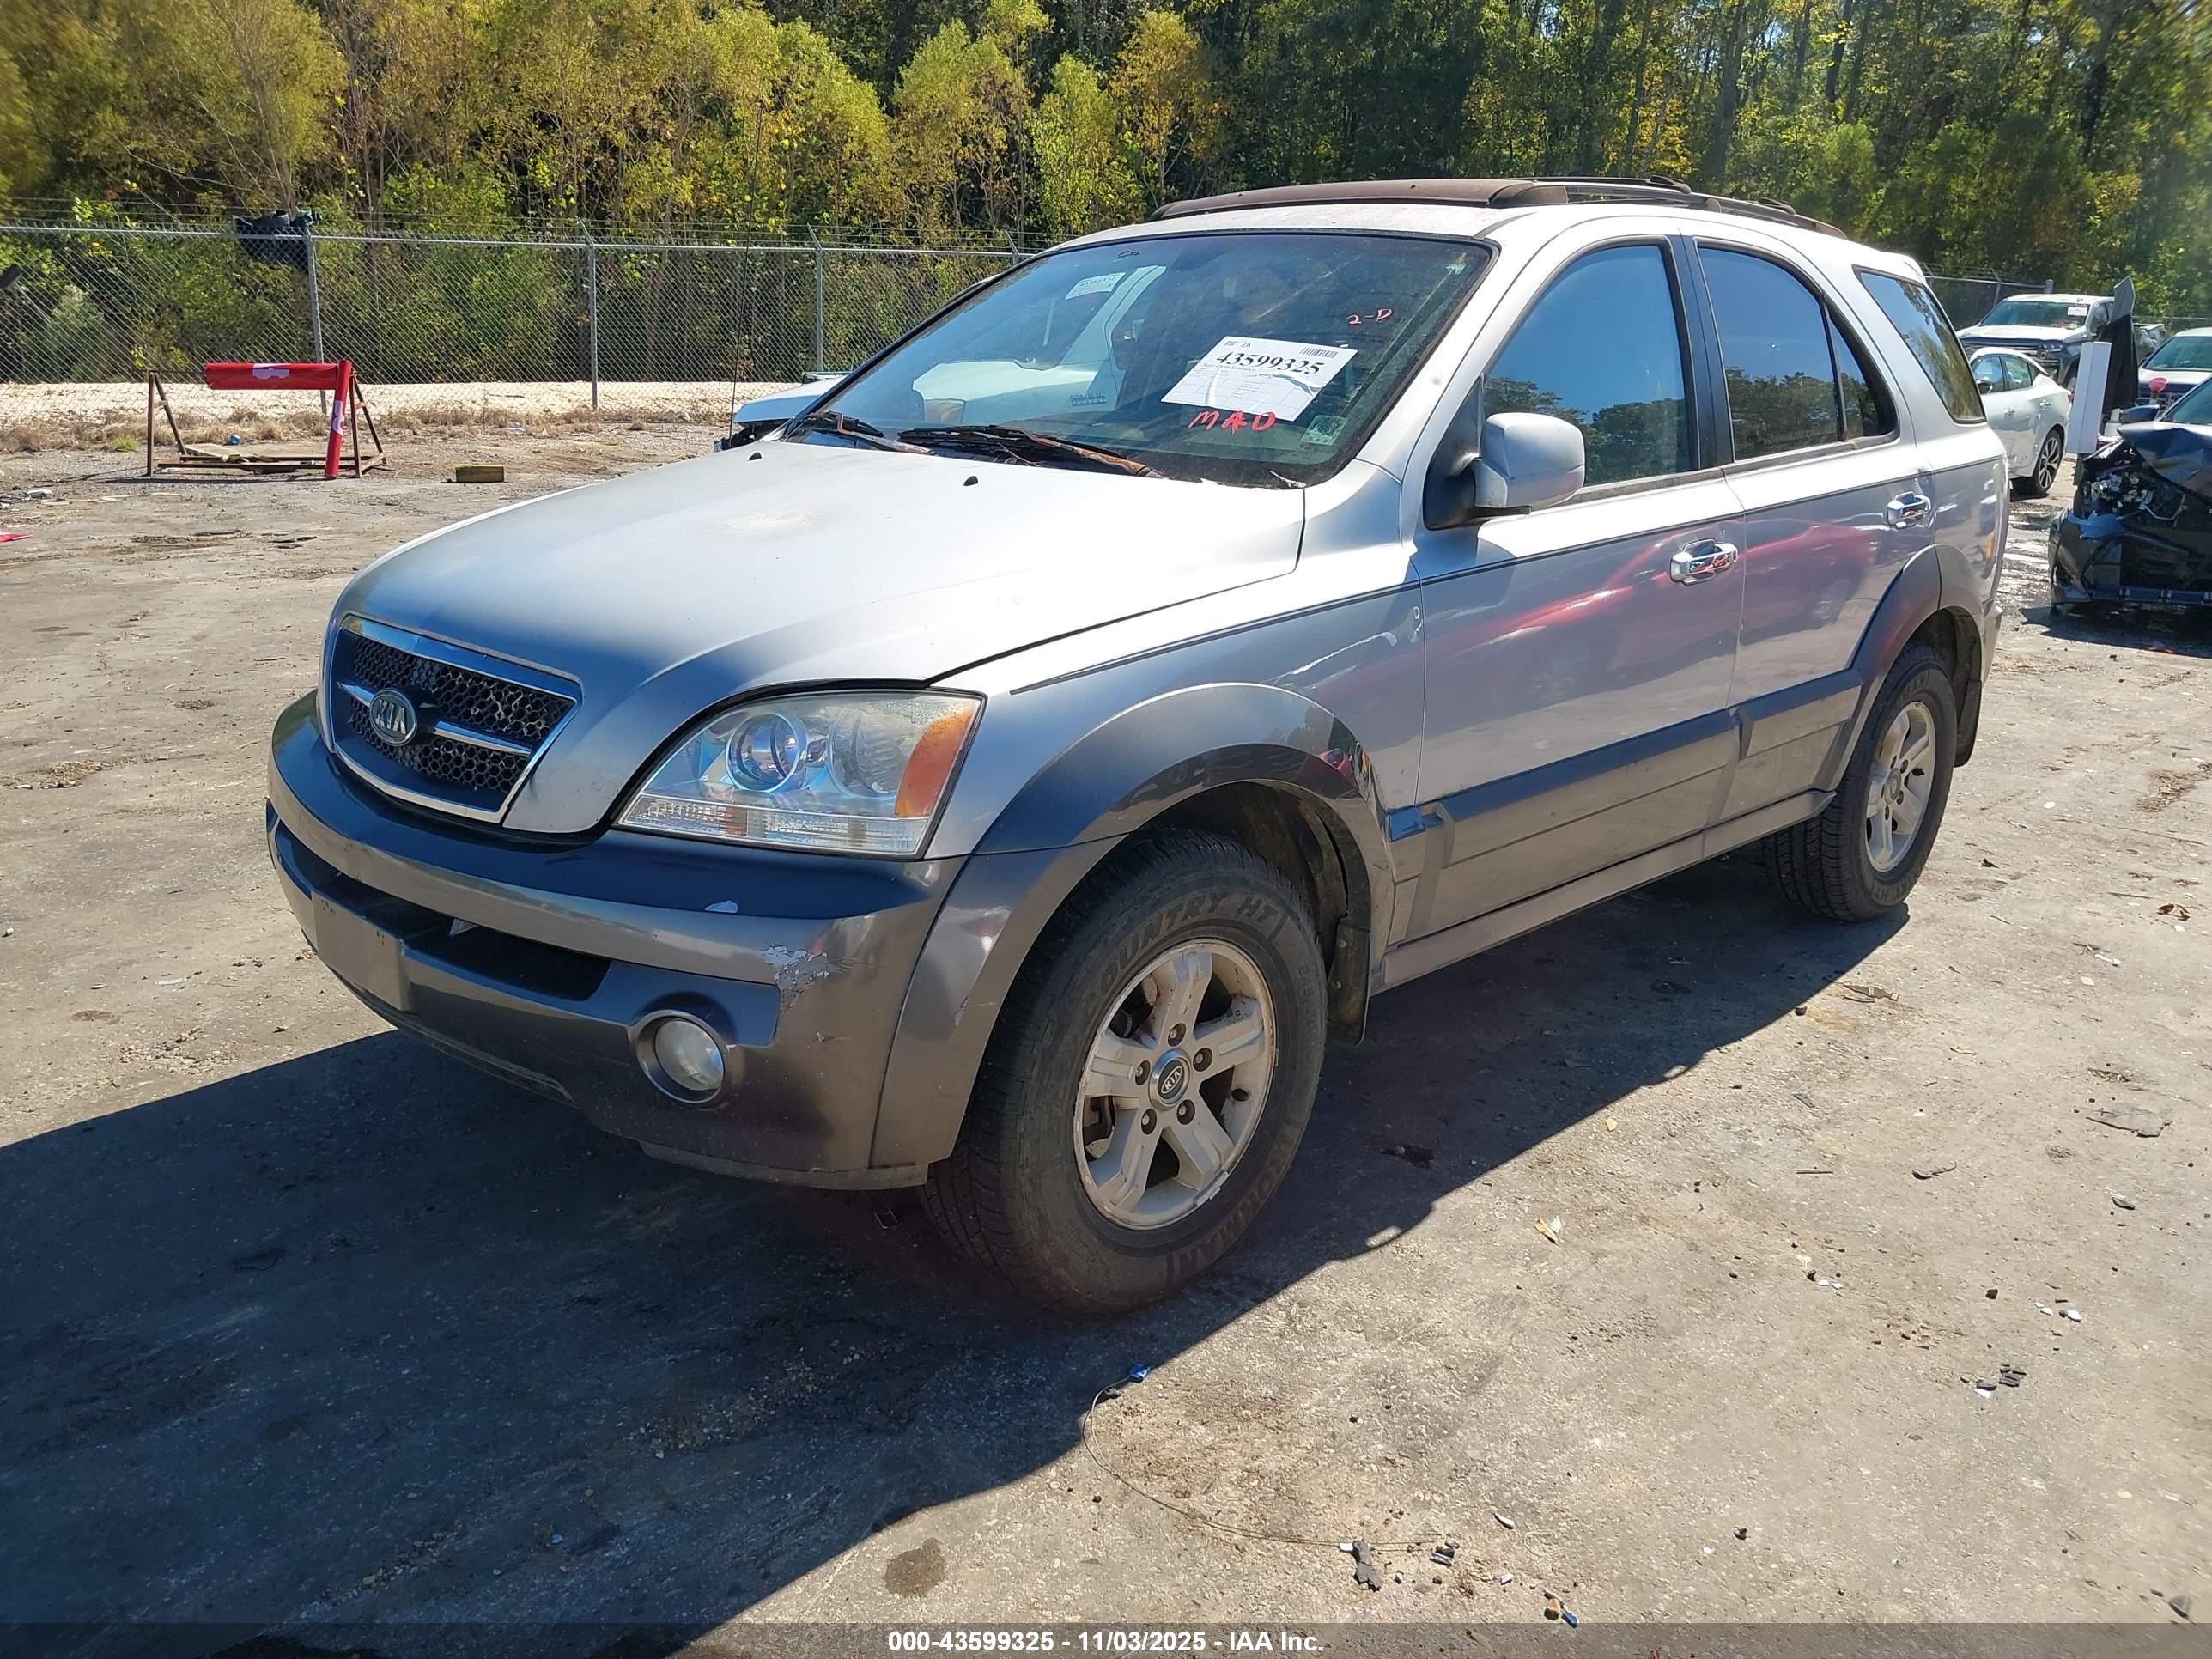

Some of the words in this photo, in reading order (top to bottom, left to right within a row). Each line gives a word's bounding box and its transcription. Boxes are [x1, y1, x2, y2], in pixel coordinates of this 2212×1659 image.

[1216, 350, 1326, 375] 43599325
[375, 699, 407, 735] KIA
[1164, 1071, 1181, 1091] KIA
